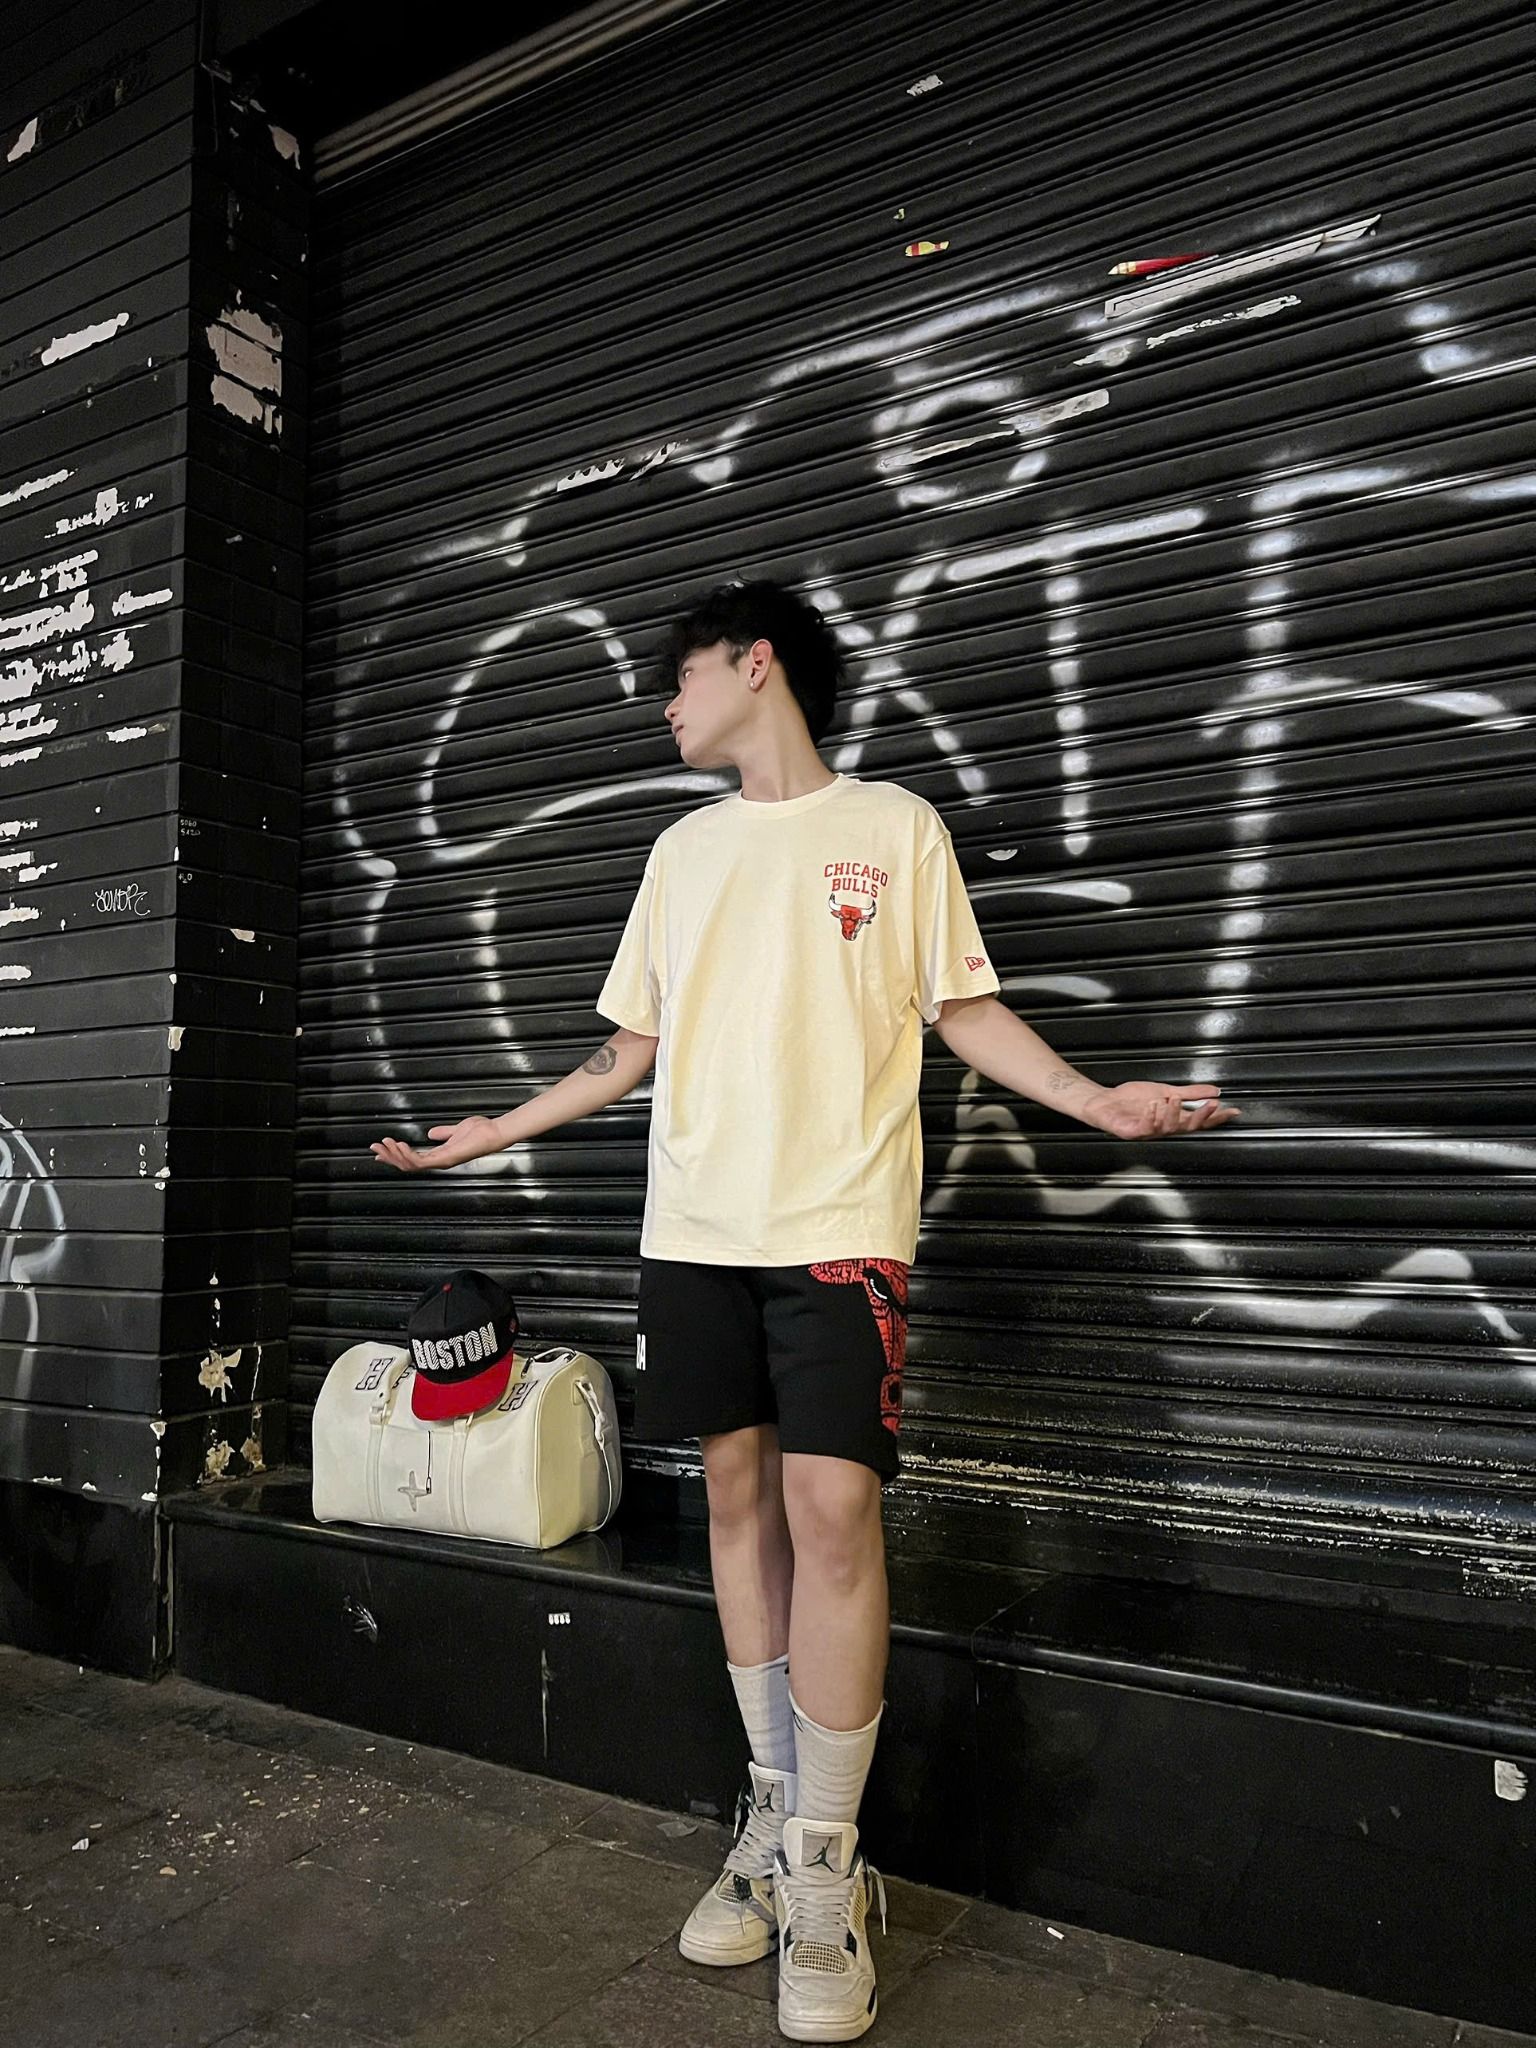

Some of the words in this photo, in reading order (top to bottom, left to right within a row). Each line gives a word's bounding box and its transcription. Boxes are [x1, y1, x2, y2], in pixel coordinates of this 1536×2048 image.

[824, 862, 888, 887] CHICAGO
[831, 878, 879, 898] BULLS
[411, 1321, 498, 1371] BOSTON
[355, 1357, 395, 1391] H
